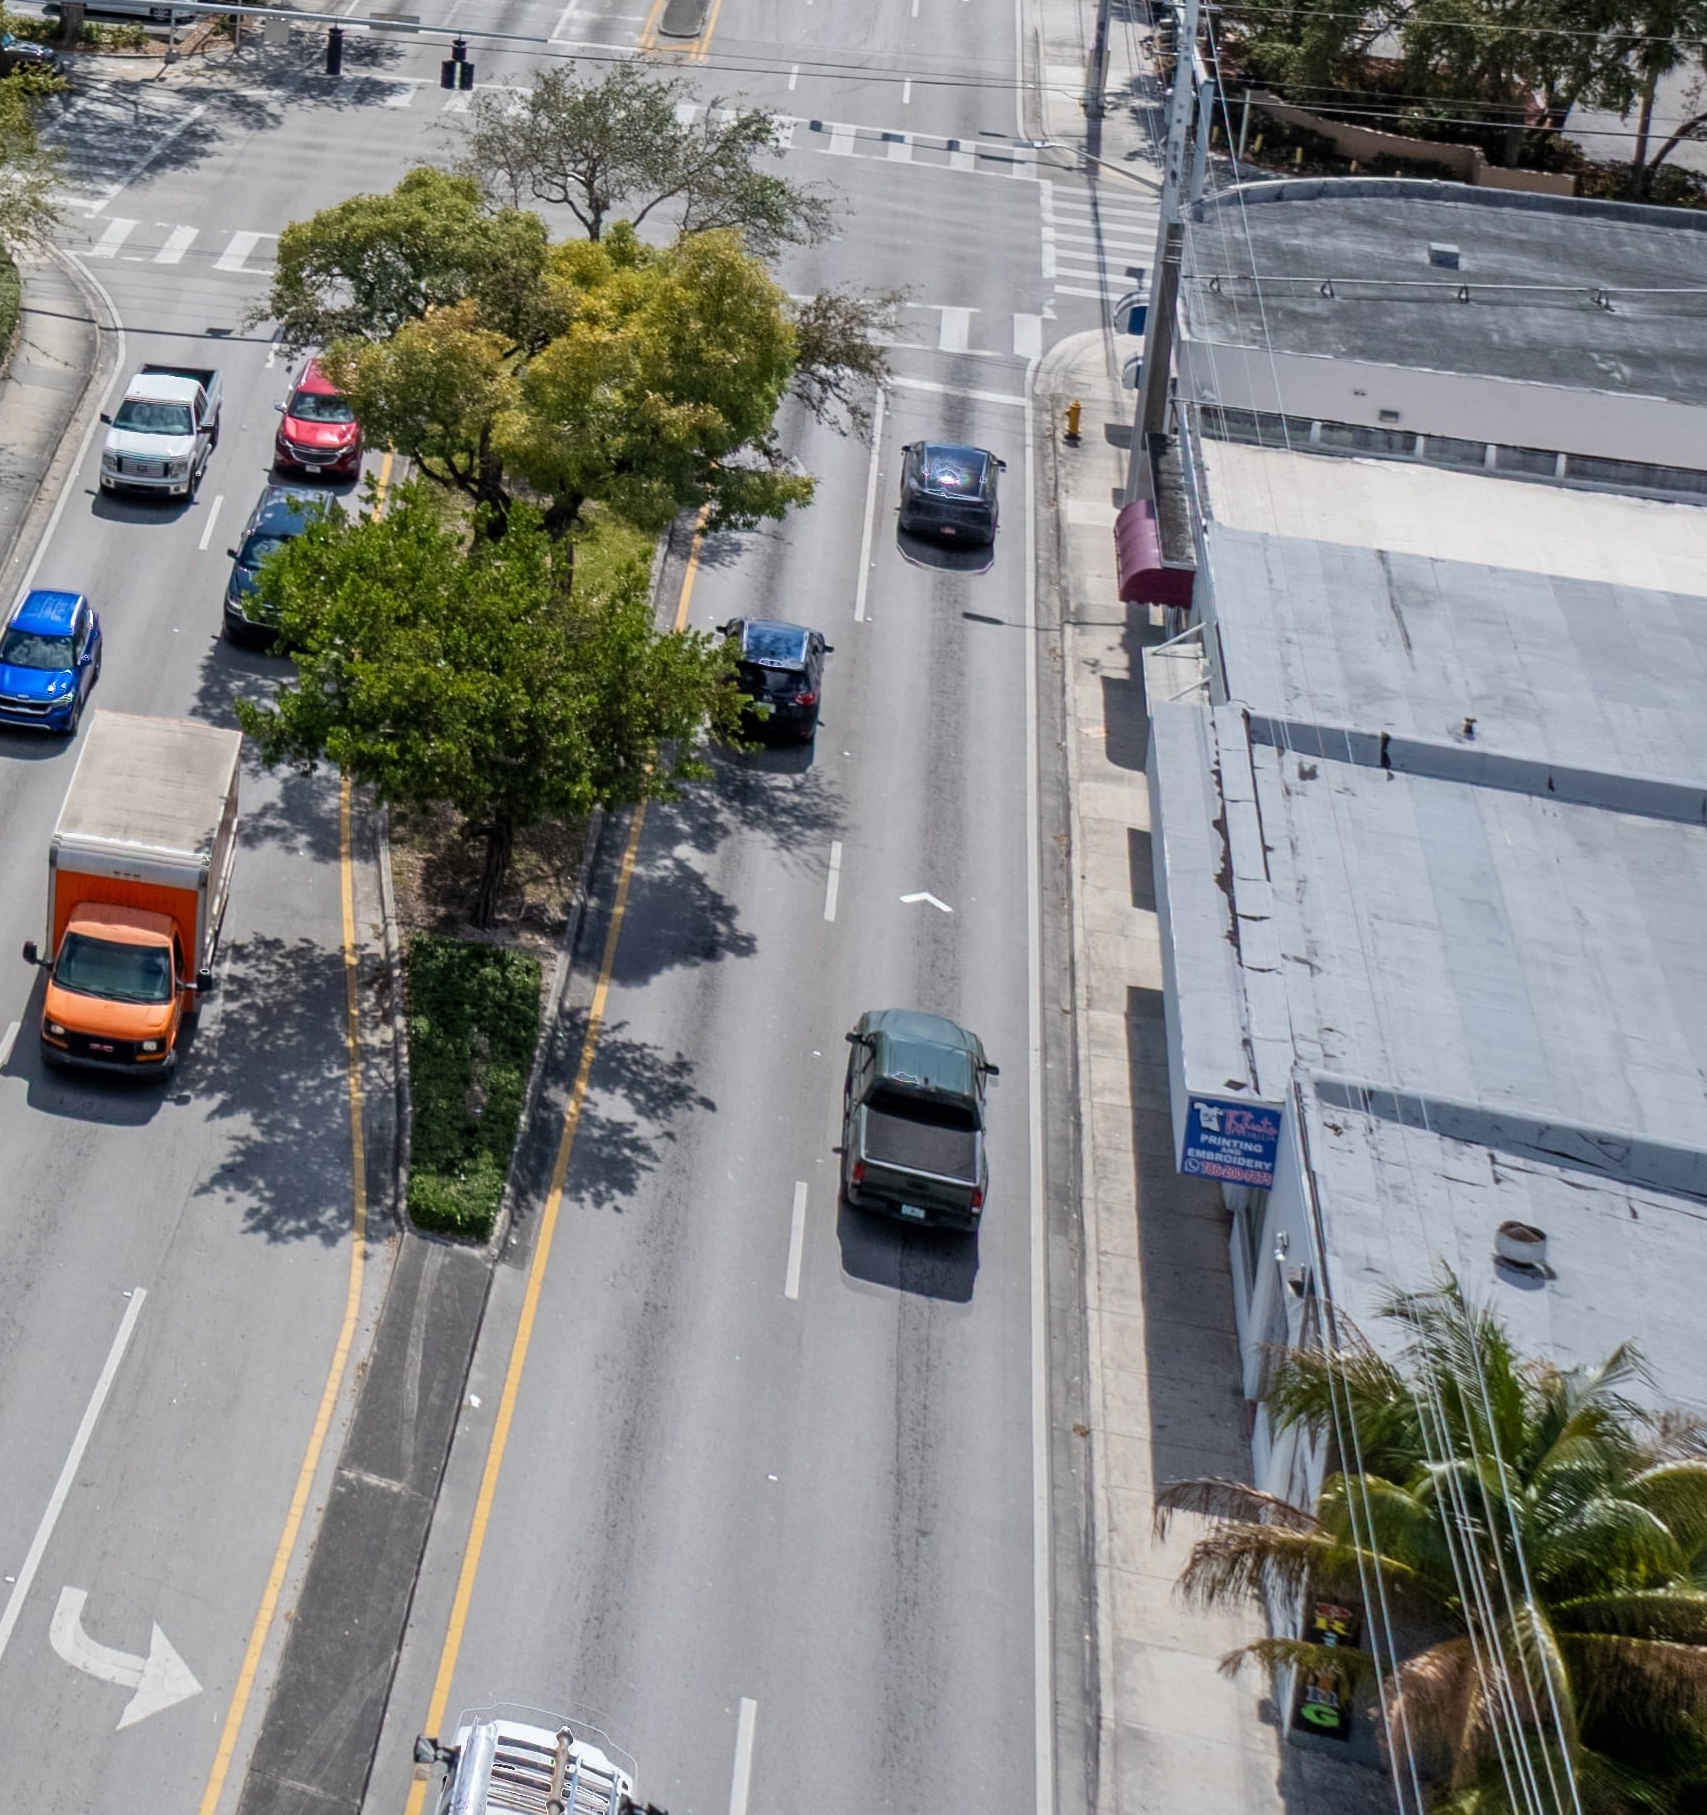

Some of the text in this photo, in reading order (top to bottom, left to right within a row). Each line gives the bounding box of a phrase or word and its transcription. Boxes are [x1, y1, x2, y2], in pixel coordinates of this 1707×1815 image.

[1200, 1133, 1263, 1153] PRINTING
[1220, 1146, 1242, 1156] AND
[1187, 1147, 1273, 1170] EMBROIDERY
